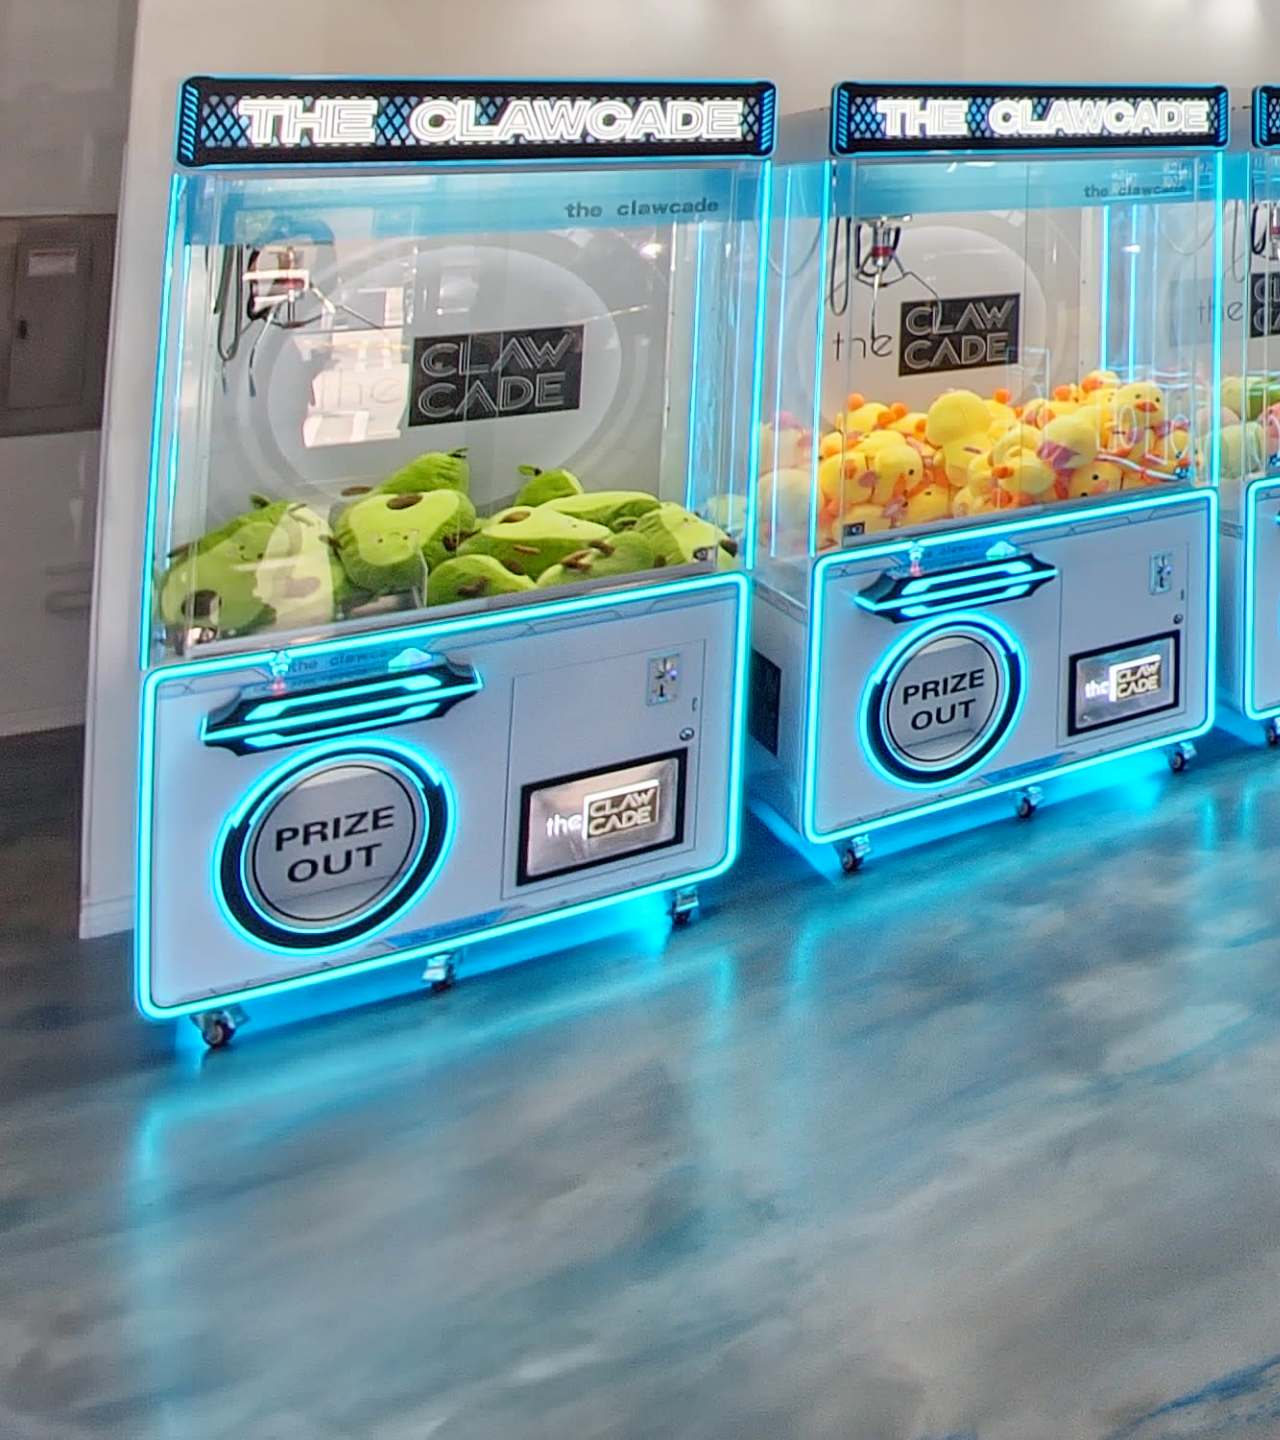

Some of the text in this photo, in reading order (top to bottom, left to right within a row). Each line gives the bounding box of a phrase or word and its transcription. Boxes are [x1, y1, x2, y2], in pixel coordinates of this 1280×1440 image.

[237, 95, 746, 145] THE CLAWCADE
[876, 98, 1211, 137] THE CLAWCADE
[564, 197, 719, 218] the clawcade
[905, 297, 1017, 337] CLAW
[420, 334, 573, 378] CLAW
[903, 332, 1009, 370] CADE
[418, 371, 566, 418] CADE
[902, 668, 985, 706] PRIZE
[1117, 662, 1160, 682] CLAW
[1117, 675, 1158, 698] CADE
[910, 698, 977, 731] OUT
[588, 805, 652, 836] CADE
[589, 788, 656, 817] CLAW
[275, 805, 395, 852] PRIZE
[546, 814, 582, 838] the
[286, 842, 384, 885] OUT
